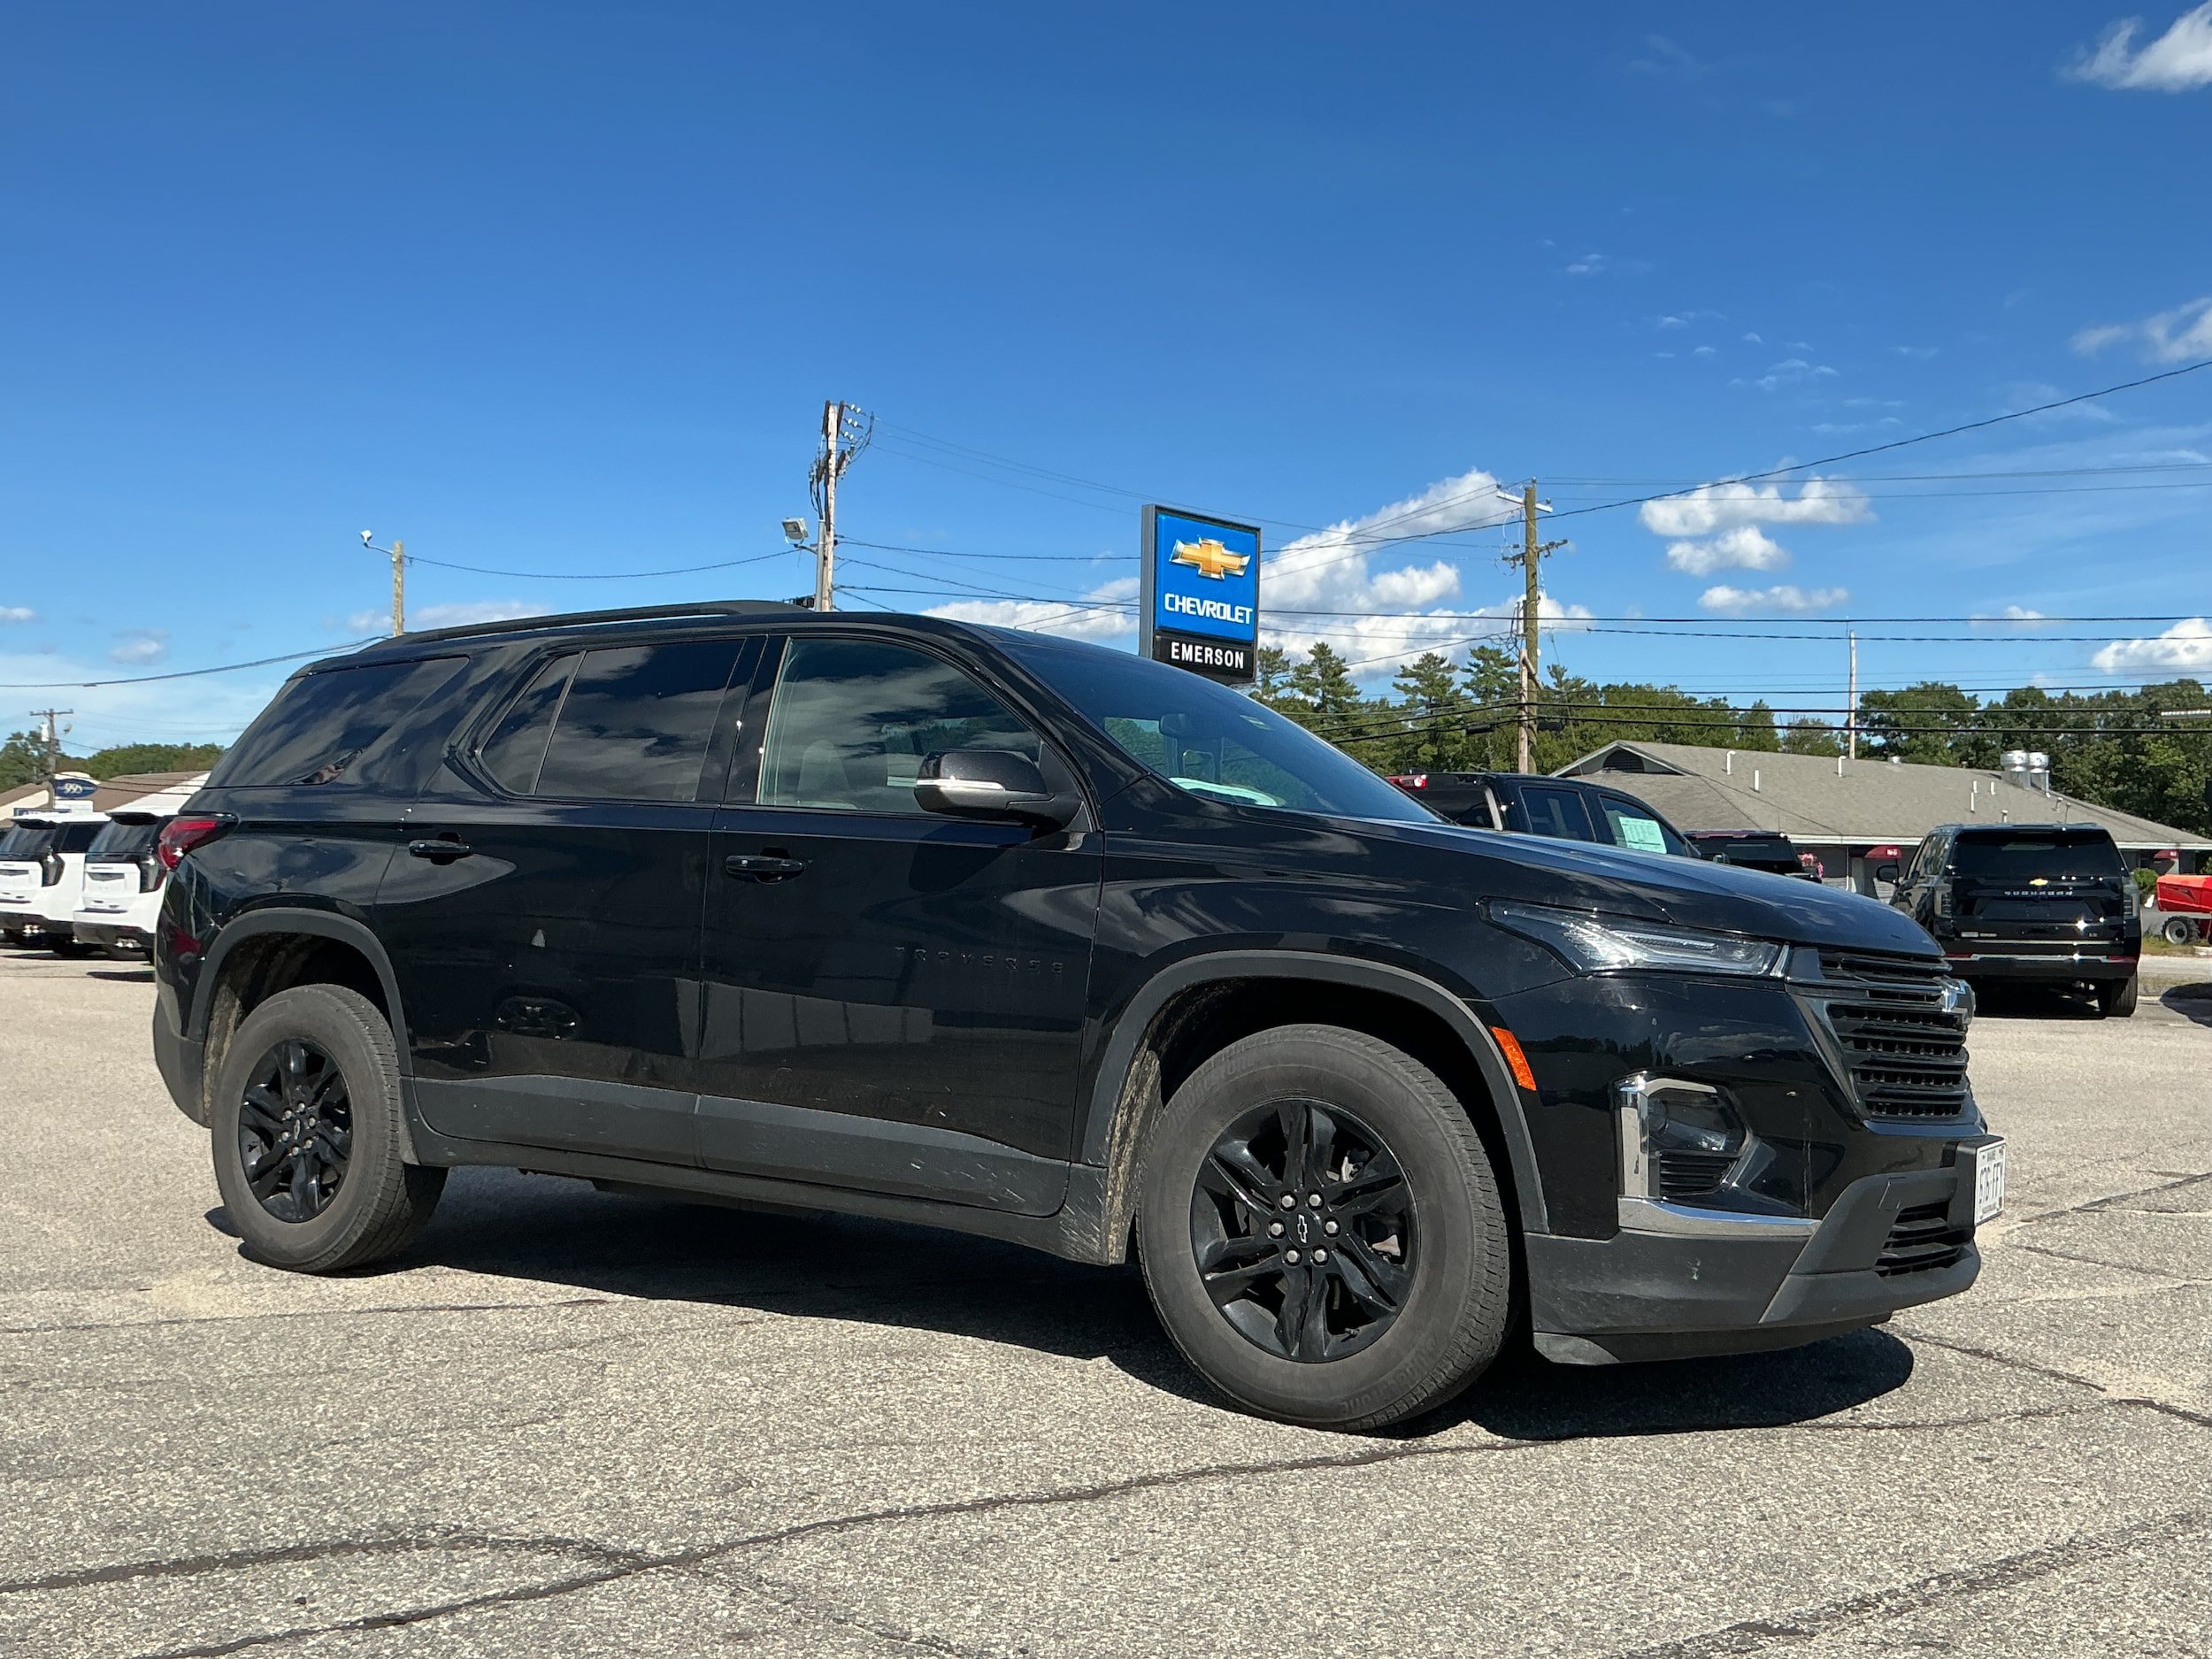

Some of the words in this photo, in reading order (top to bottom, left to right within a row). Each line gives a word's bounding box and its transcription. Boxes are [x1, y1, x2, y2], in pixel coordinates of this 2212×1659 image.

[1164, 593, 1253, 625] CHEVROLET
[1171, 641, 1244, 670] EMERSON
[895, 945, 1064, 974] TRAVERSE
